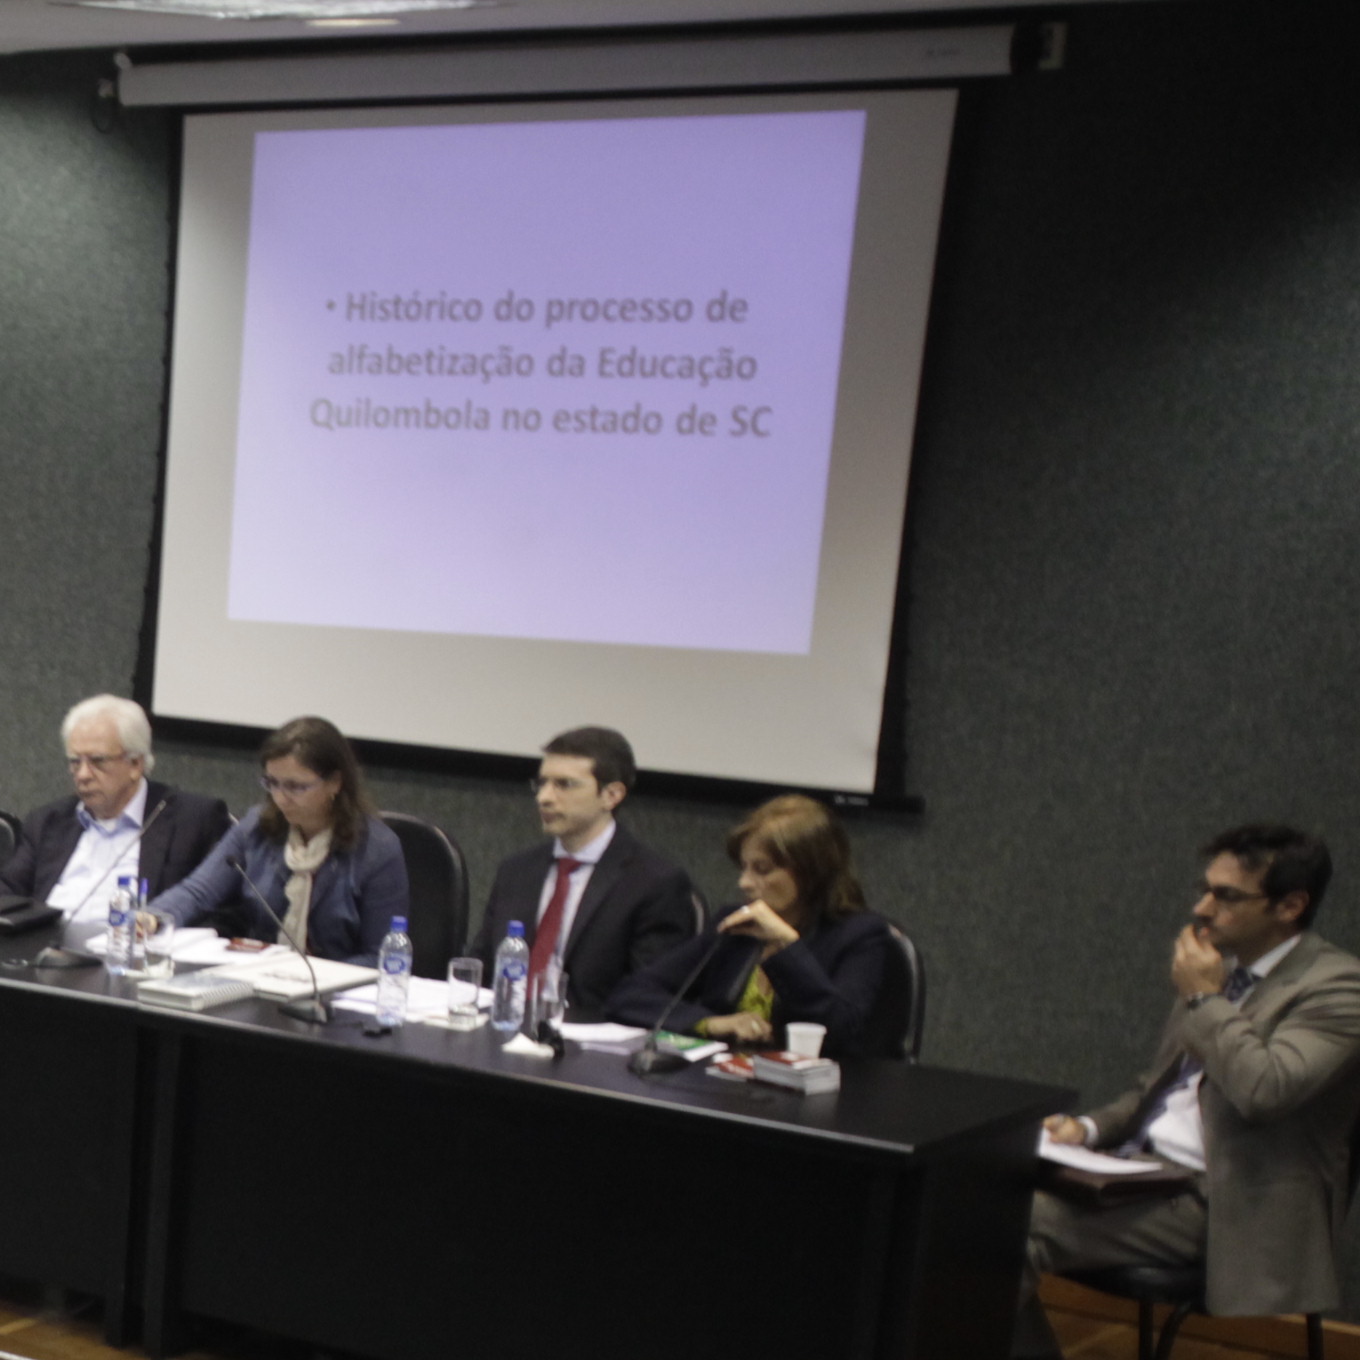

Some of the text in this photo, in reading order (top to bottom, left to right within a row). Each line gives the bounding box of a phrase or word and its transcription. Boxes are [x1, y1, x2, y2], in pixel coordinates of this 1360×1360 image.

[345, 290, 749, 329] Histórico do processo de
[328, 344, 758, 387] alfabetização da Educação
[309, 397, 773, 438] Quilombola no estado de SC
